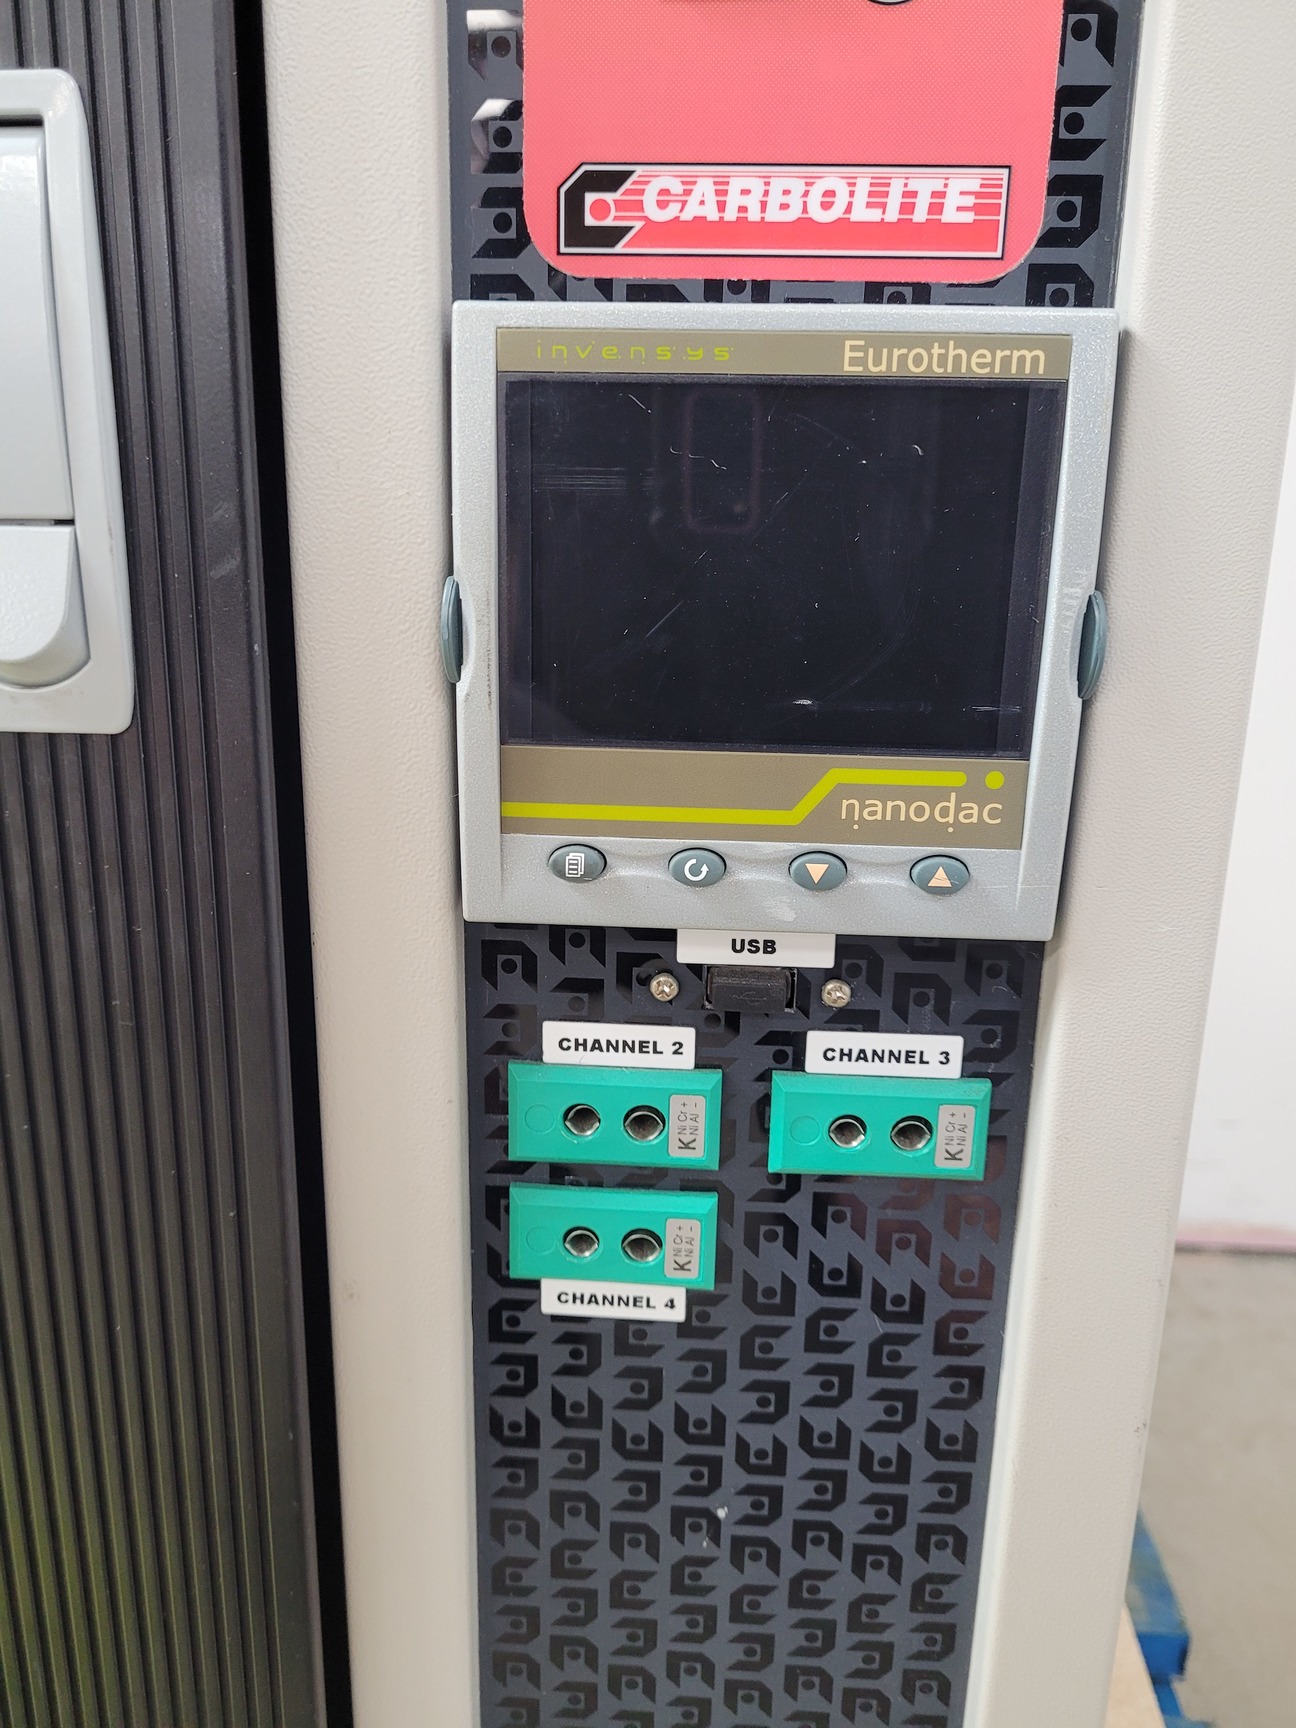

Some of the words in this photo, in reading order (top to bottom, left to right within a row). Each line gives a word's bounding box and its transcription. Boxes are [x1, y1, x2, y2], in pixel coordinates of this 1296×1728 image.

[641, 175, 983, 225] CARBOLITE
[536, 341, 734, 366] invensys
[842, 339, 1046, 376] Eurotherm
[840, 792, 1003, 833] nanodac
[731, 938, 777, 954] USB
[558, 1037, 664, 1055] CHANNEL
[671, 1041, 684, 1056] 2
[822, 1047, 930, 1065] CHANNEL
[938, 1050, 950, 1065] 3
[557, 1292, 656, 1309] CHANNEL
[664, 1298, 676, 1310] 4
